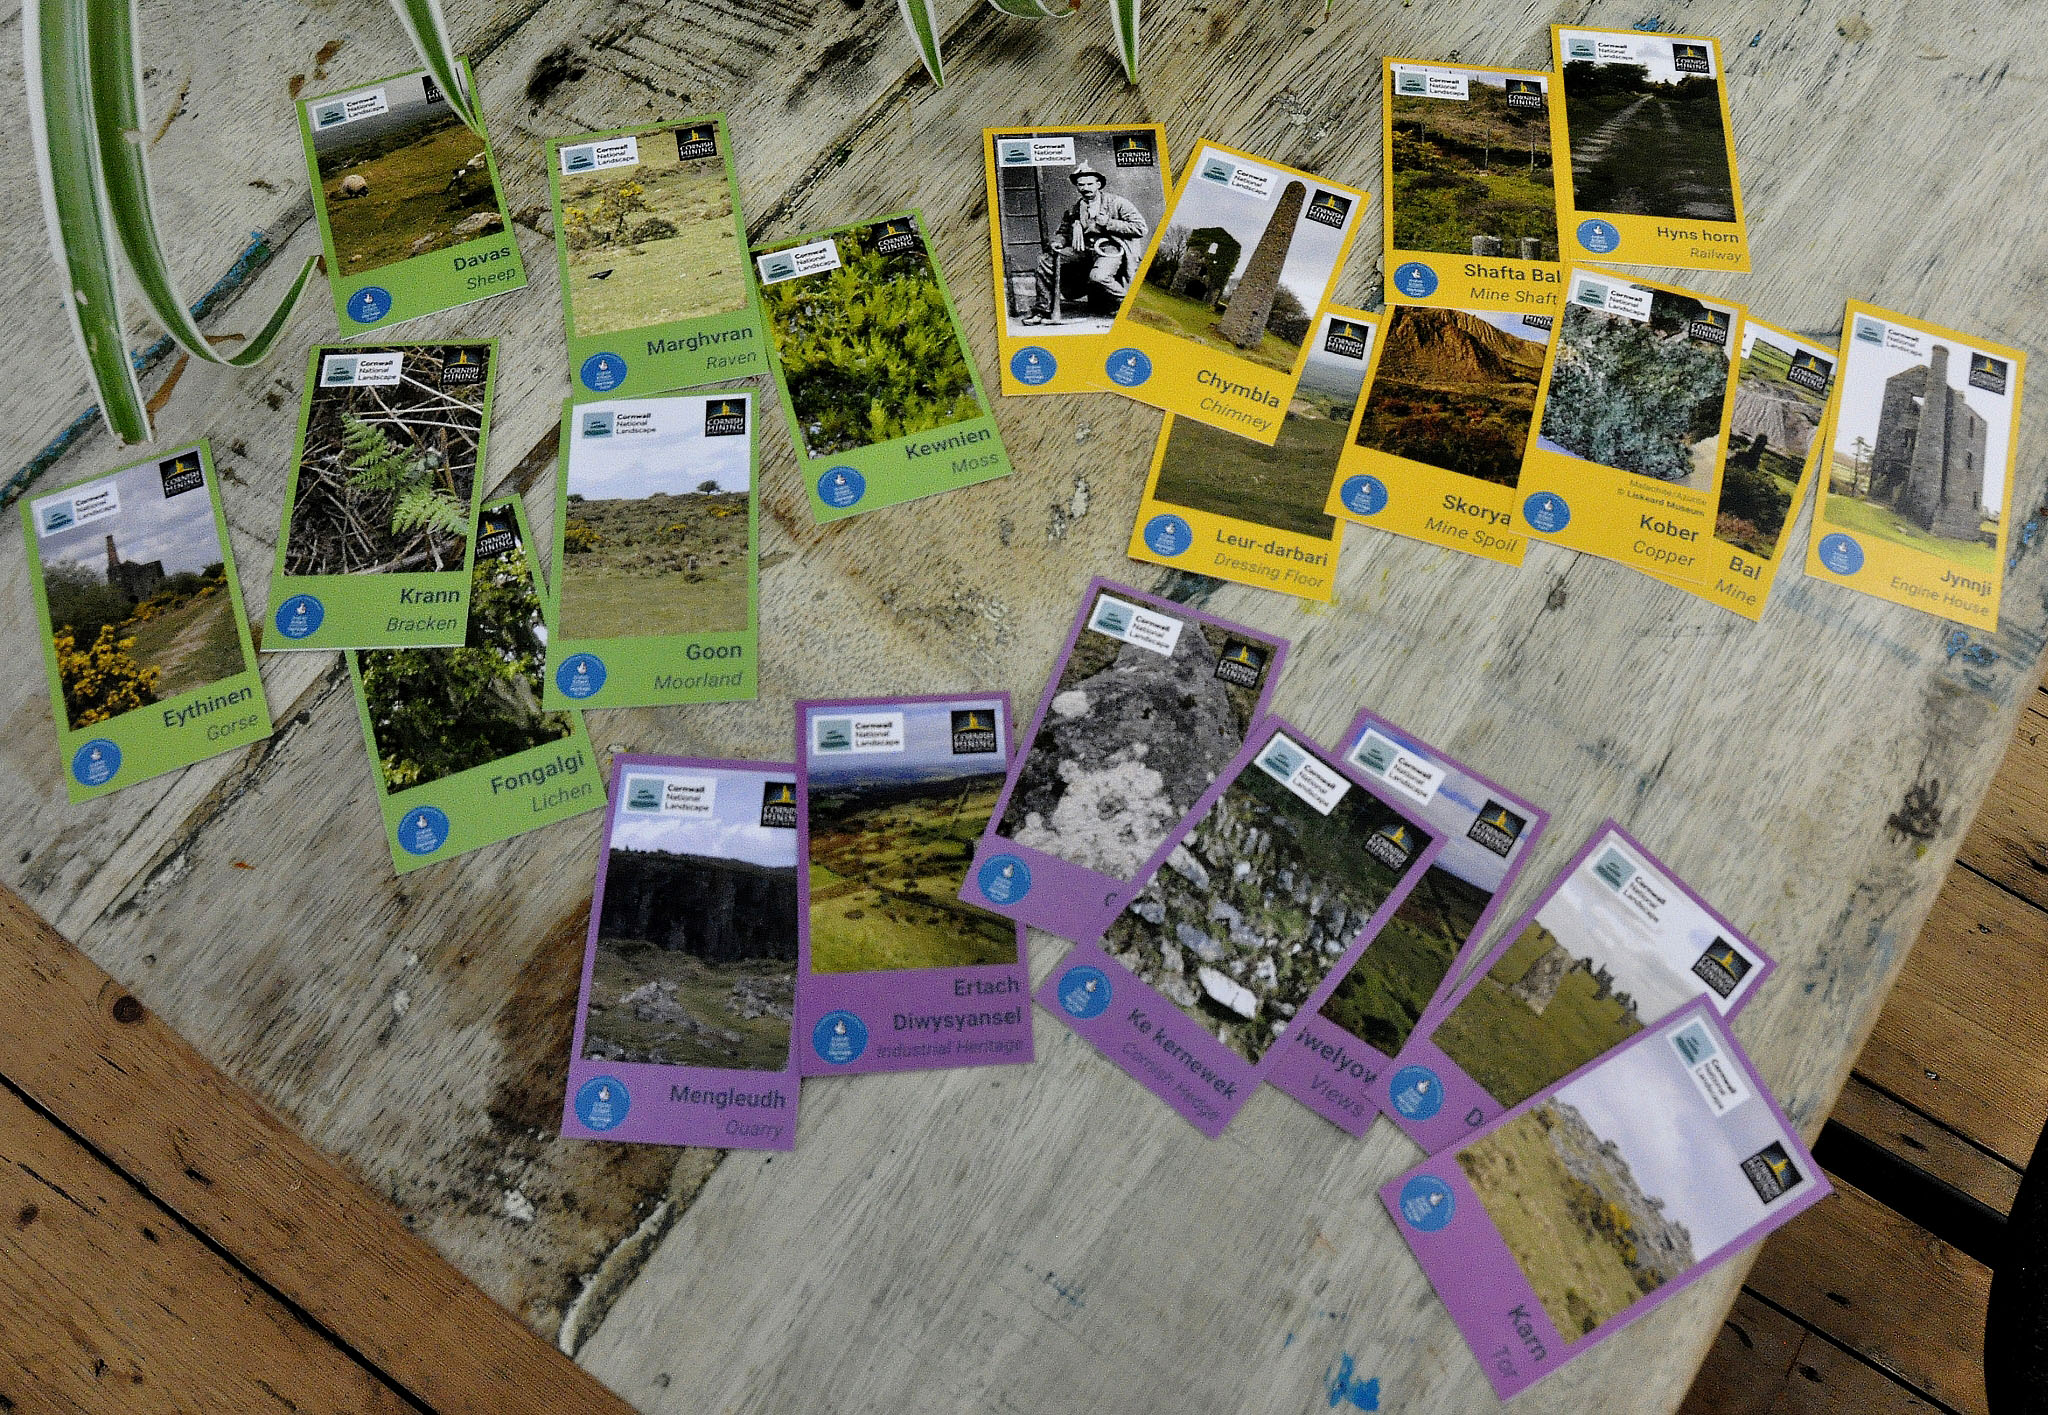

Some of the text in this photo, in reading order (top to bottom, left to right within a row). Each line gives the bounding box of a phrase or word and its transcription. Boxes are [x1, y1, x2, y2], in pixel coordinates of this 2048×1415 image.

[1508, 94, 1540, 102] CORNISH
[596, 144, 628, 153] Cornwall
[680, 142, 713, 152] CORNISH
[681, 148, 714, 157] MINING
[598, 156, 636, 166] Landscape
[1236, 170, 1268, 183] Cornwall
[1309, 211, 1342, 224] MINING
[1311, 205, 1344, 219] CORNISH
[878, 234, 912, 247] CORNISH
[1658, 226, 1739, 243] Hyns horn
[794, 248, 827, 259] Cornwall
[880, 240, 914, 252] MINING
[1690, 247, 1742, 262] Railway
[454, 248, 510, 272] Davas
[467, 268, 516, 290] Sheep
[1464, 264, 1560, 284] Shafta Bal
[1470, 288, 1558, 305] Mine Shaft
[647, 327, 753, 356] Marghvran
[1327, 342, 1362, 354] MINING
[1328, 336, 1363, 348] CORNISH
[706, 351, 757, 370] Raven
[1196, 369, 1280, 408] Chymbla
[1200, 397, 1272, 433] Chimney
[707, 424, 744, 432] MINING
[905, 428, 991, 460] Kewnien
[952, 453, 1000, 474] Moss
[1443, 494, 1511, 526] Skorya
[1425, 517, 1518, 553] Mine Spoil
[1640, 514, 1700, 542] Kober
[1216, 529, 1328, 568] Leur-darbari
[1634, 540, 1696, 567] Copper
[1213, 552, 1324, 588] Dressing Floor
[1729, 556, 1762, 580] Bal
[1716, 578, 1757, 606] Mine
[1940, 570, 1992, 597] Jynnji
[400, 588, 460, 604] Krann
[1890, 576, 1990, 617] Engine House
[386, 616, 458, 632] Bracken
[686, 644, 742, 660] Goon
[654, 671, 742, 690] Moorland
[163, 687, 252, 728] Eythinen
[207, 714, 258, 741] Gorse
[490, 750, 585, 795] Fongalgi
[532, 782, 592, 812] Lichen
[954, 976, 1020, 997] Ertach
[894, 1006, 1022, 1032] Diwysyansel
[1127, 1008, 1238, 1100] Ke kernewek
[670, 1084, 786, 1109] Mengleudh
[1310, 1075, 1366, 1117] Views
[1510, 1304, 1547, 1362] Karn
